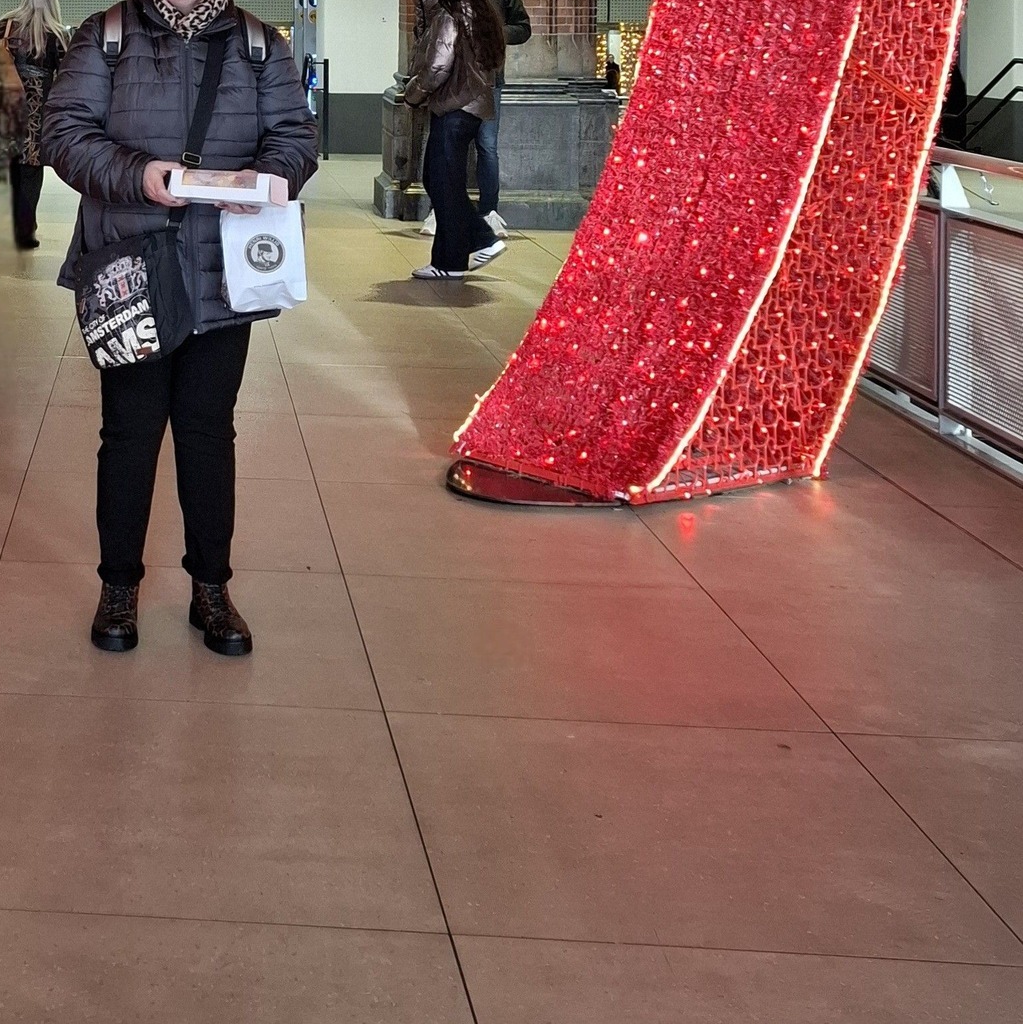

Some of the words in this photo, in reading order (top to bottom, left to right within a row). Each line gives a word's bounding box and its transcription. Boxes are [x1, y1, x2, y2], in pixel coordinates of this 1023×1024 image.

[85, 299, 150, 347] AMSTERDAM
[89, 319, 99, 330] CITY
[98, 314, 106, 323] OF
[95, 317, 161, 369] AMS
